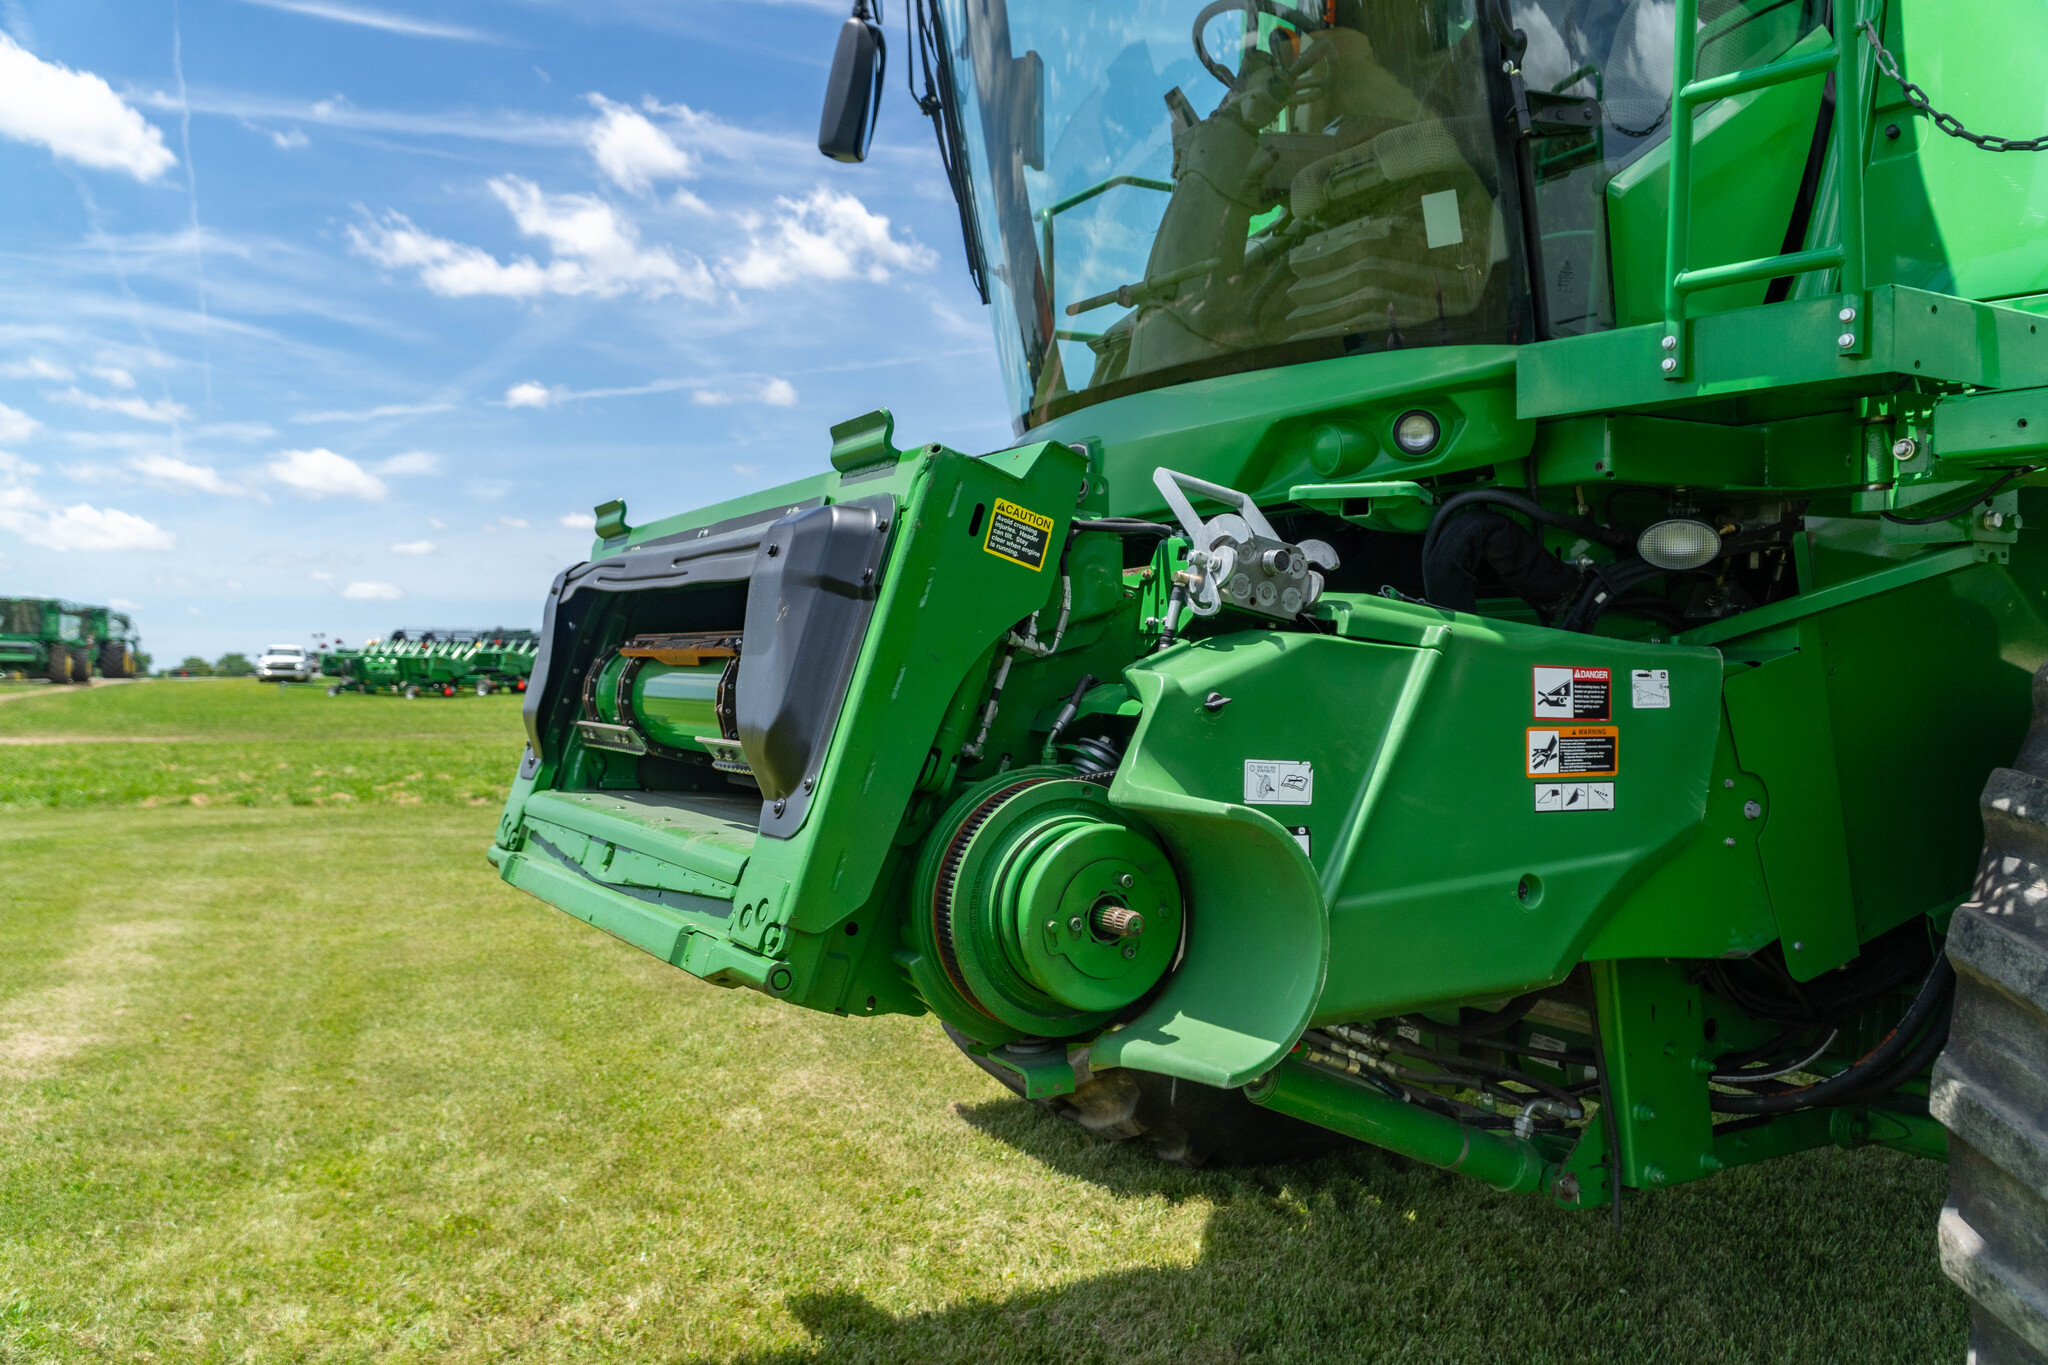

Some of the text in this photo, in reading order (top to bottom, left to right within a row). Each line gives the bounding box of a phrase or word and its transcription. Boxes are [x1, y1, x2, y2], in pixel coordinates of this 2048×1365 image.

[996, 514, 1038, 536] Avoid crushing
[1005, 504, 1051, 530] CAUTION
[993, 528, 1029, 546] can tilt. Stay
[994, 521, 1039, 542] injuries. Header
[991, 535, 1041, 558] clear when engine
[995, 544, 1019, 557] running.
[1580, 670, 1608, 679] DANGER
